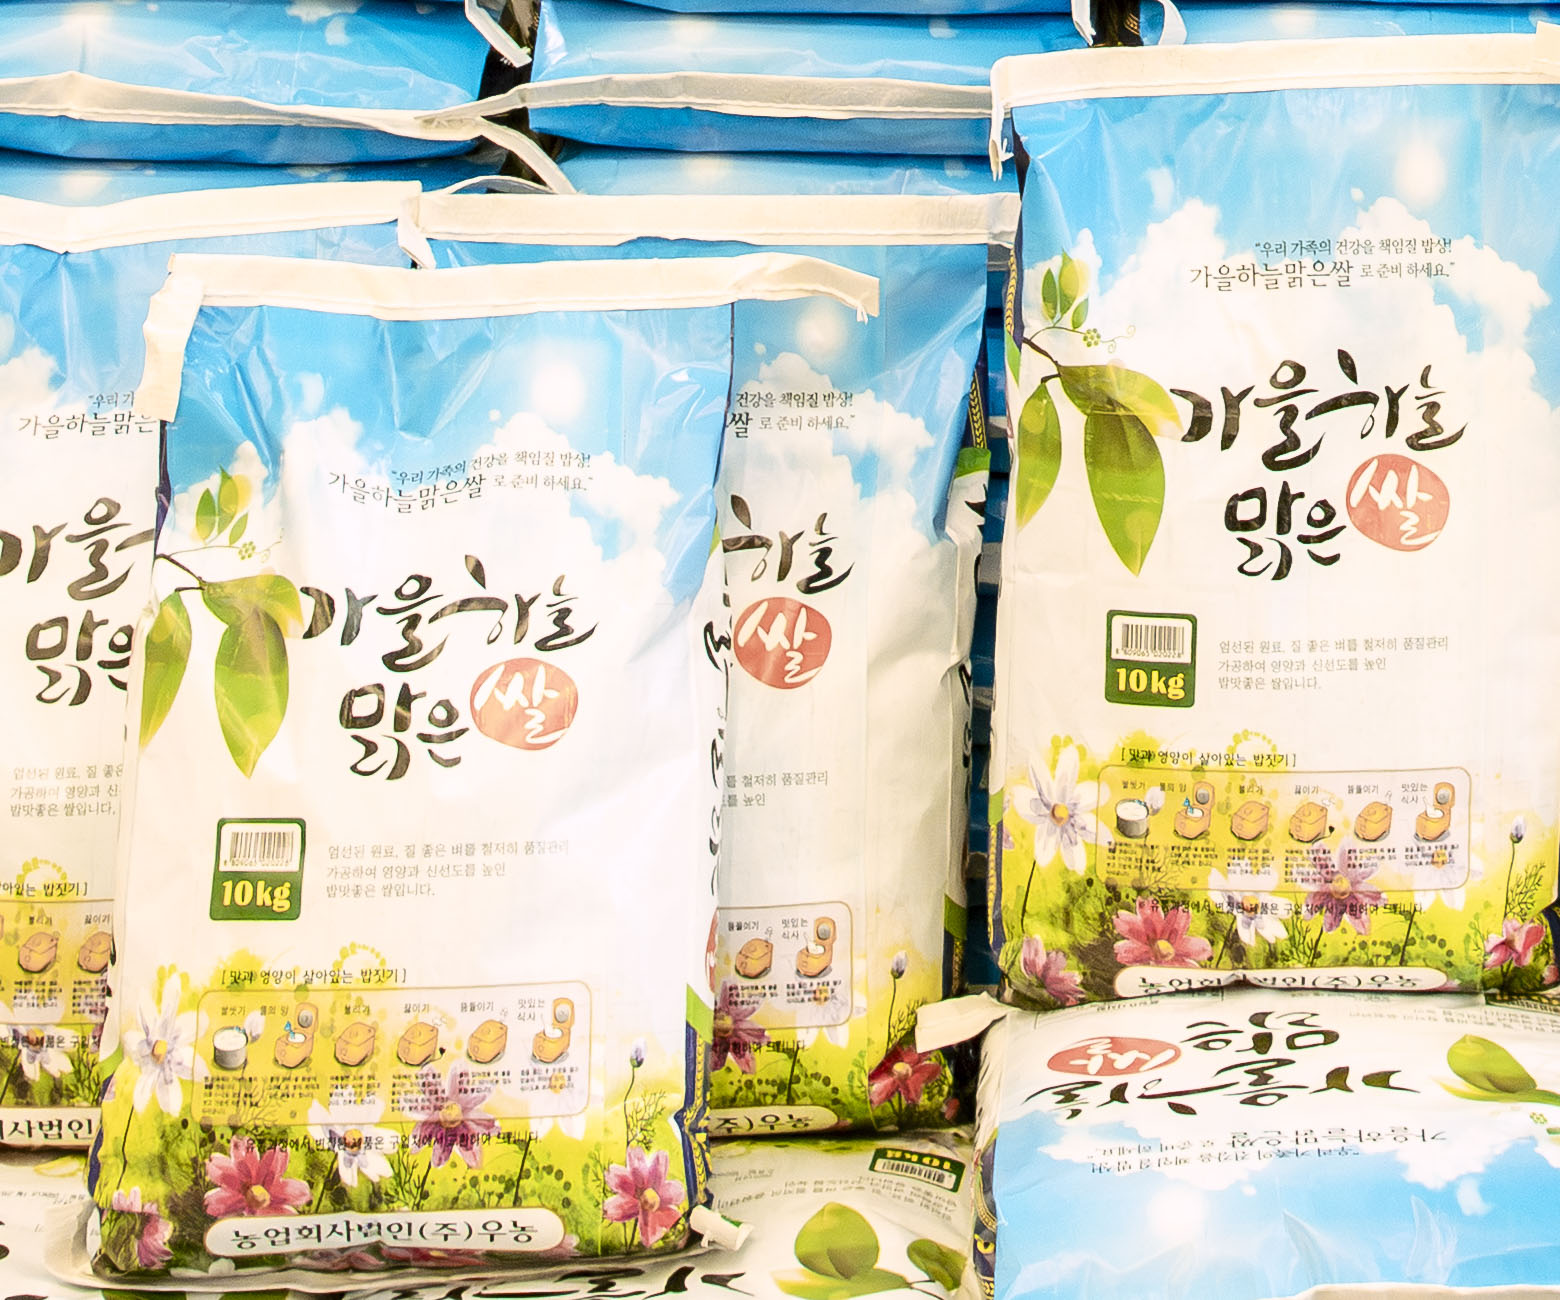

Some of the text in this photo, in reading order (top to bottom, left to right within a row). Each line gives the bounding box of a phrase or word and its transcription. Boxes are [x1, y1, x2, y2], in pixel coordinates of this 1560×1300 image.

[1291, 239, 1331, 257] 가족의
[1336, 239, 1374, 256] 건강을
[1379, 239, 1416, 255] 책임질
[1421, 238, 1452, 254] 밥상!
[1190, 260, 1354, 292] 가을하늘맑은쌀
[1377, 263, 1402, 278] 준비
[1170, 349, 1469, 471] 가을하늘
[428, 462, 466, 481] 가족의
[471, 451, 509, 471] 건강을
[515, 450, 555, 467] 책임질
[560, 451, 591, 469] 밥상!
[328, 472, 486, 514] 가을하늘맑은쌀
[512, 474, 538, 489] 준비
[1224, 480, 1347, 581] 맑은
[300, 554, 599, 672] 가을하늘
[1117, 668, 1186, 699] 10kg
[339, 682, 469, 780] 맑은
[222, 880, 291, 912] 10kg
